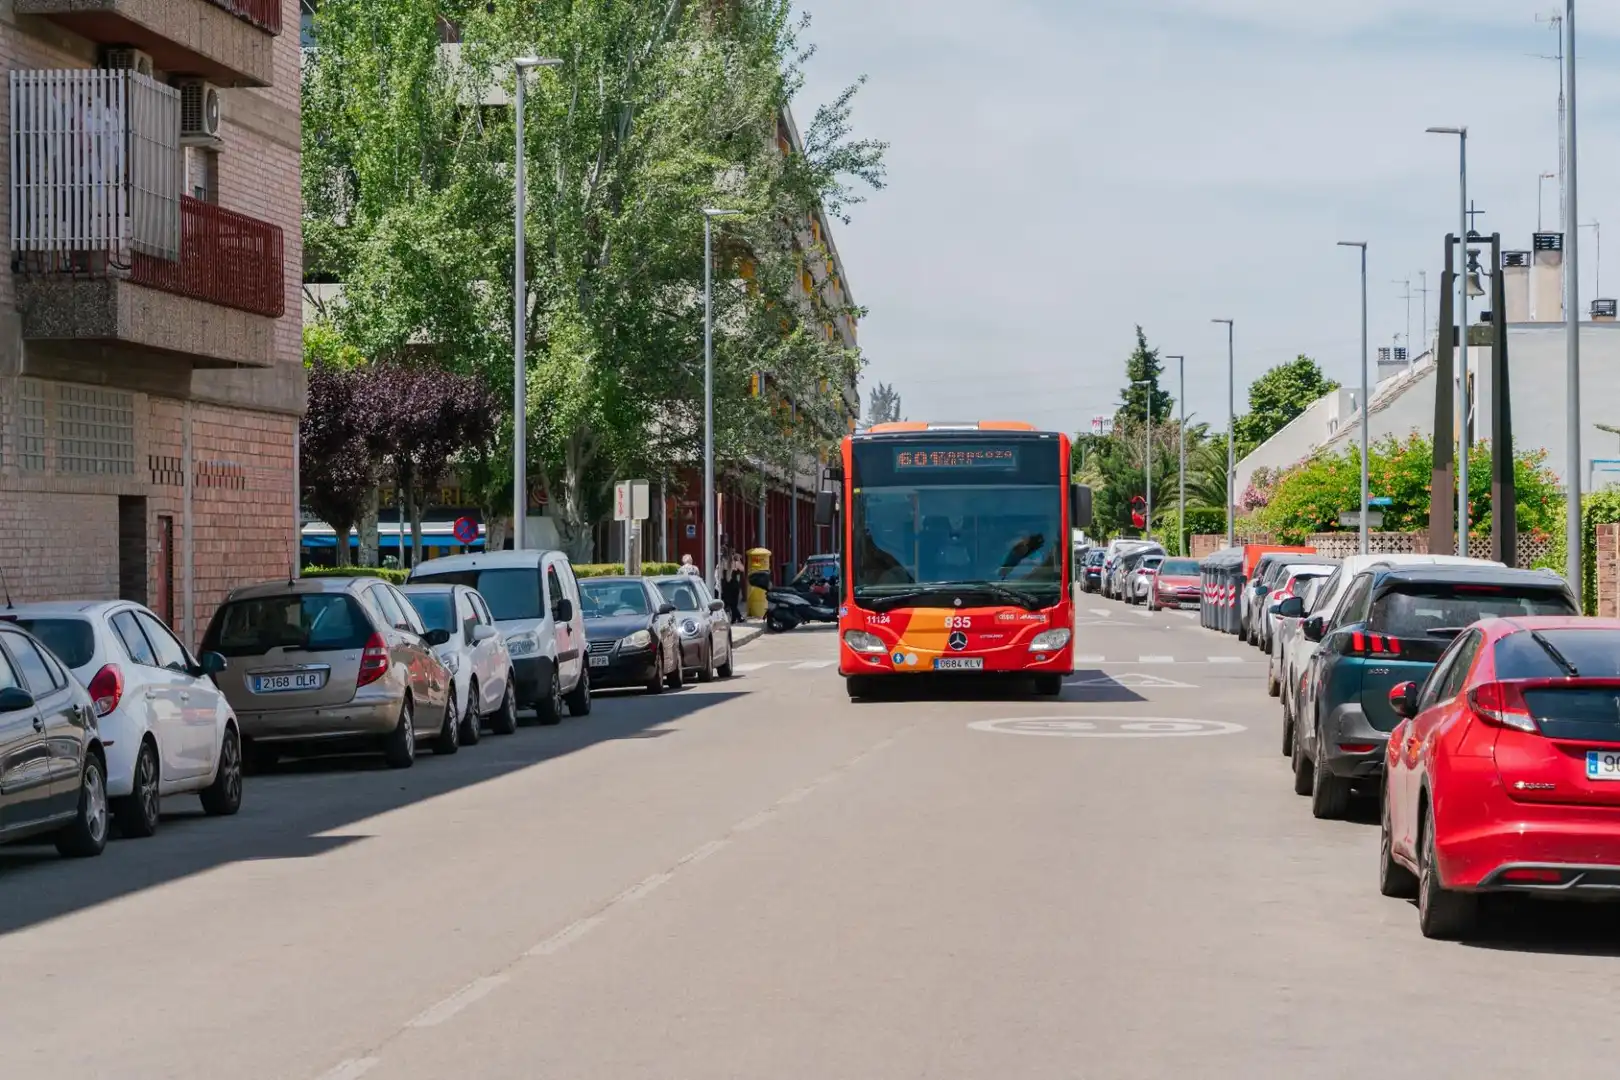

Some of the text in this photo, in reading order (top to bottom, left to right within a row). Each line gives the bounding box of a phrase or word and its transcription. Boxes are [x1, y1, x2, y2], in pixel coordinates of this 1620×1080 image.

[866, 615, 891, 624] 11124
[944, 616, 971, 628] 835
[940, 659, 982, 668] 0684 KLV
[263, 674, 317, 689] 2168 DLR
